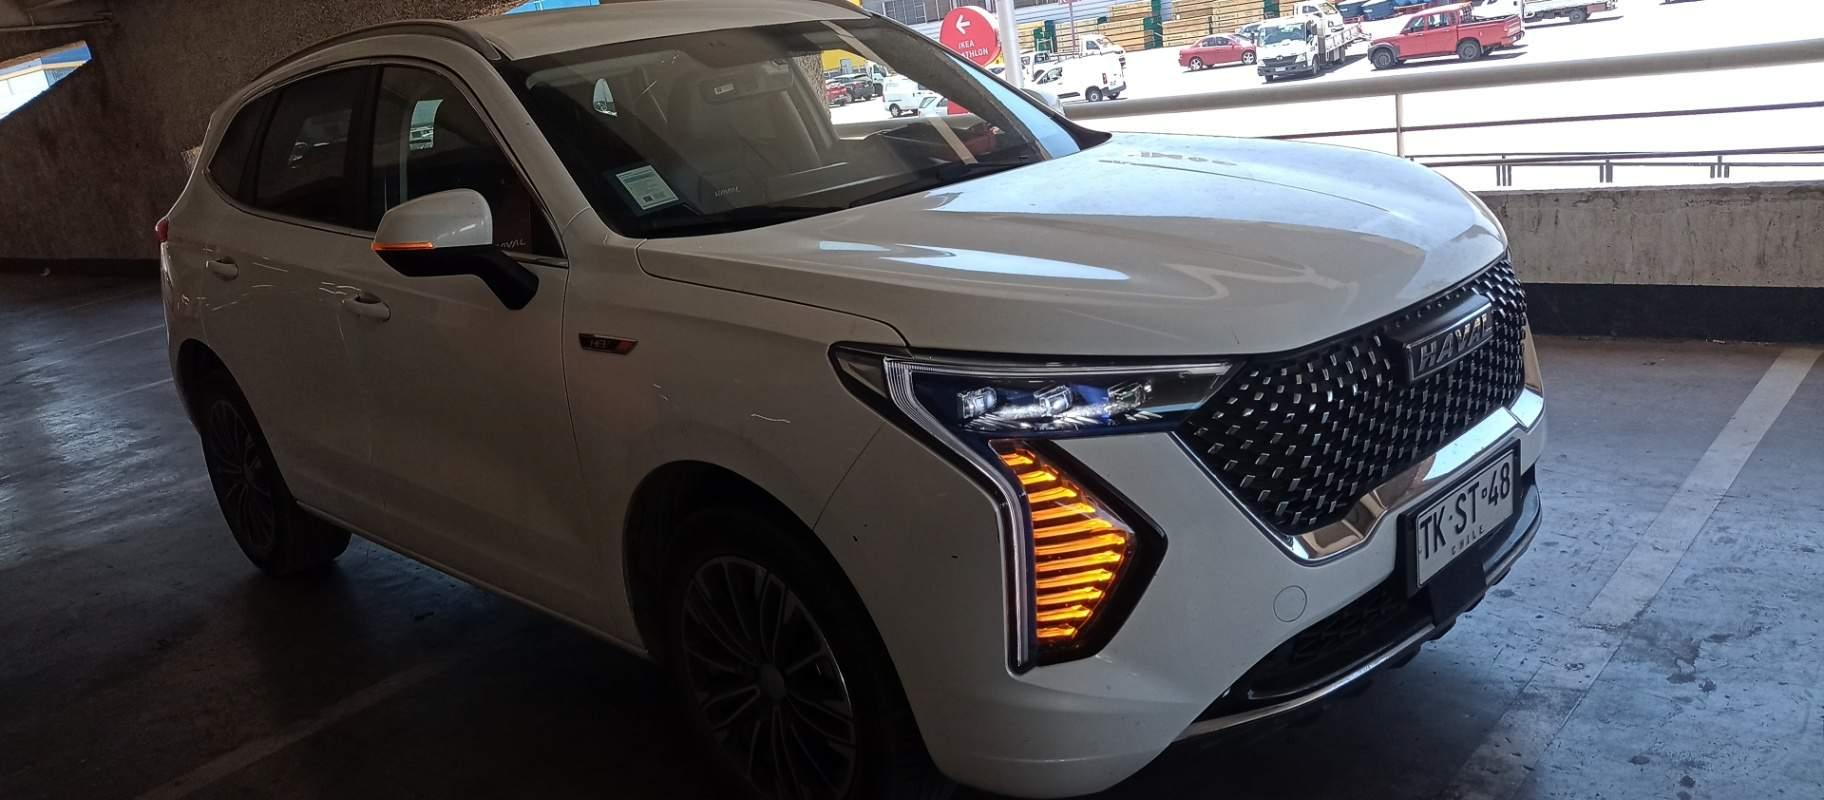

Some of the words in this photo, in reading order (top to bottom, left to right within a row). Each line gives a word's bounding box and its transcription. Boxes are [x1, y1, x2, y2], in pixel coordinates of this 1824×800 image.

[958, 40, 975, 49] IKEA
[1418, 313, 1493, 372] HAVAL
[1452, 525, 1485, 556] CHILE
